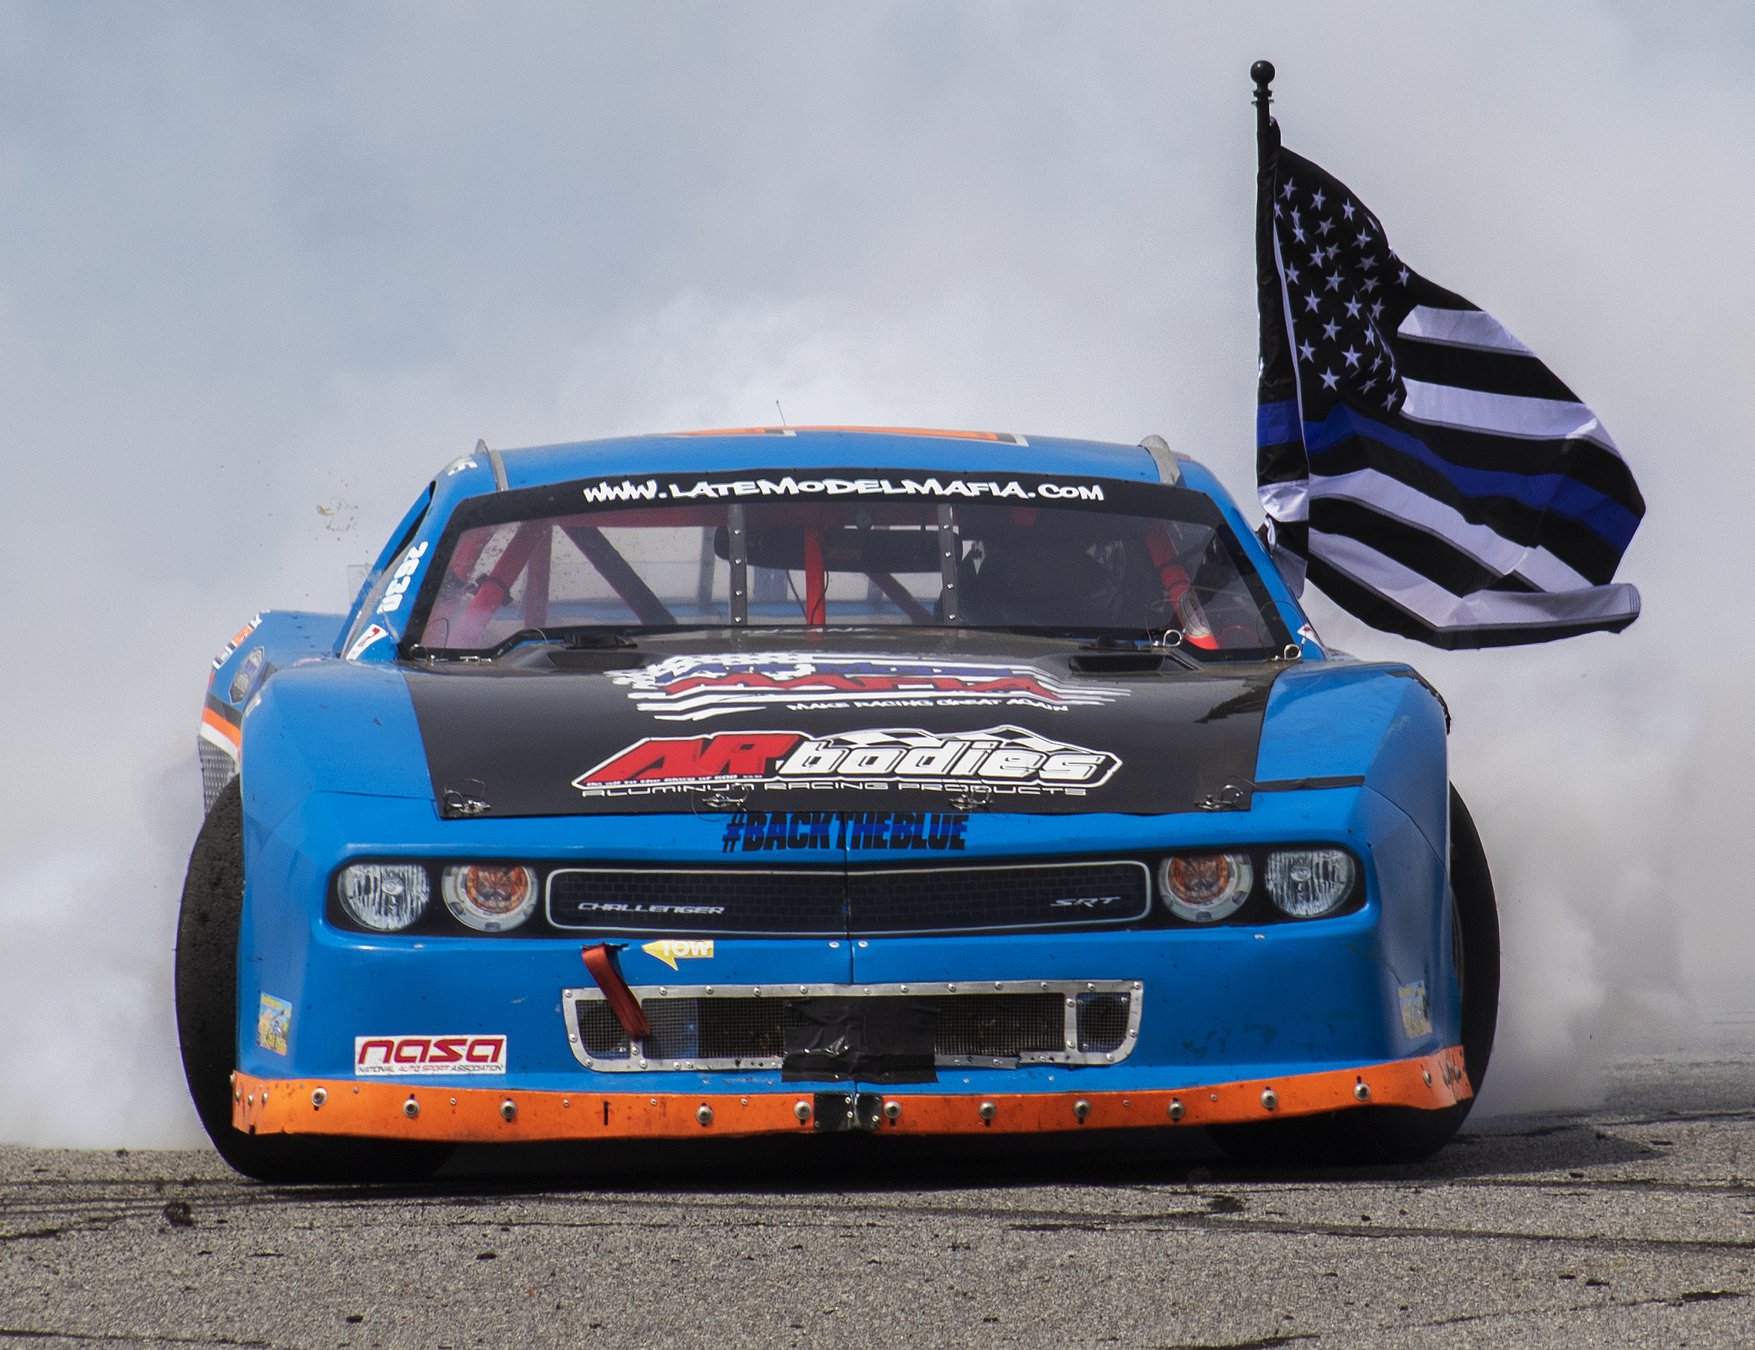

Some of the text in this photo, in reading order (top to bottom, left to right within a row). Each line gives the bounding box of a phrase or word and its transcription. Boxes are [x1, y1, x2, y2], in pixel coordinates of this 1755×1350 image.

[786, 702, 850, 711] MAKE
[854, 700, 934, 708] RACING
[1006, 698, 1068, 711] AGAIN
[582, 782, 1086, 797] ALUMINUM RACING PRODUCTS
[722, 812, 969, 853] #BACKTHEBLUE
[578, 902, 725, 914] CHALLENGER
[1050, 896, 1121, 908] SRT
[662, 940, 711, 956] TOW
